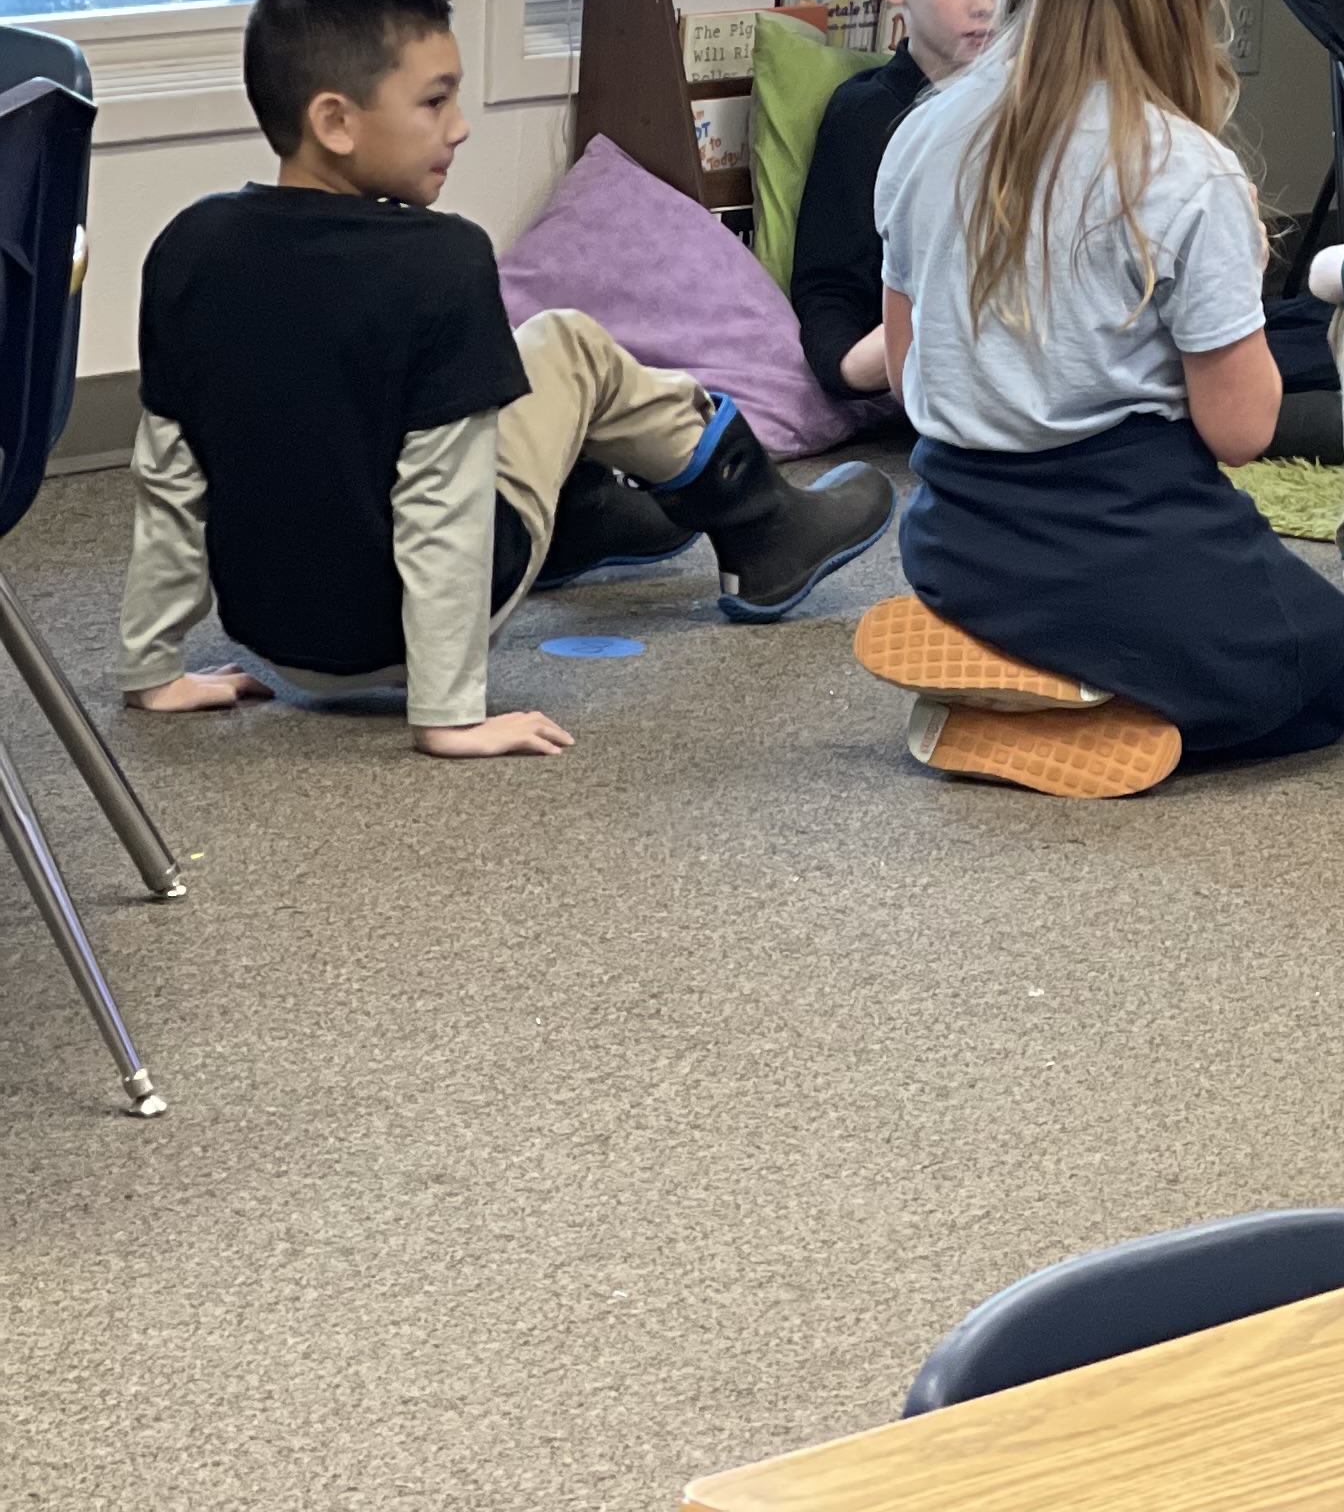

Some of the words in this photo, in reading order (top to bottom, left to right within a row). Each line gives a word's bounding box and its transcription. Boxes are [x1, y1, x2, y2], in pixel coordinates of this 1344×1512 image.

[694, 25, 721, 40] The
[729, 20, 754, 39] Pig
[693, 46, 725, 62] Will
[733, 44, 750, 59] Ri
